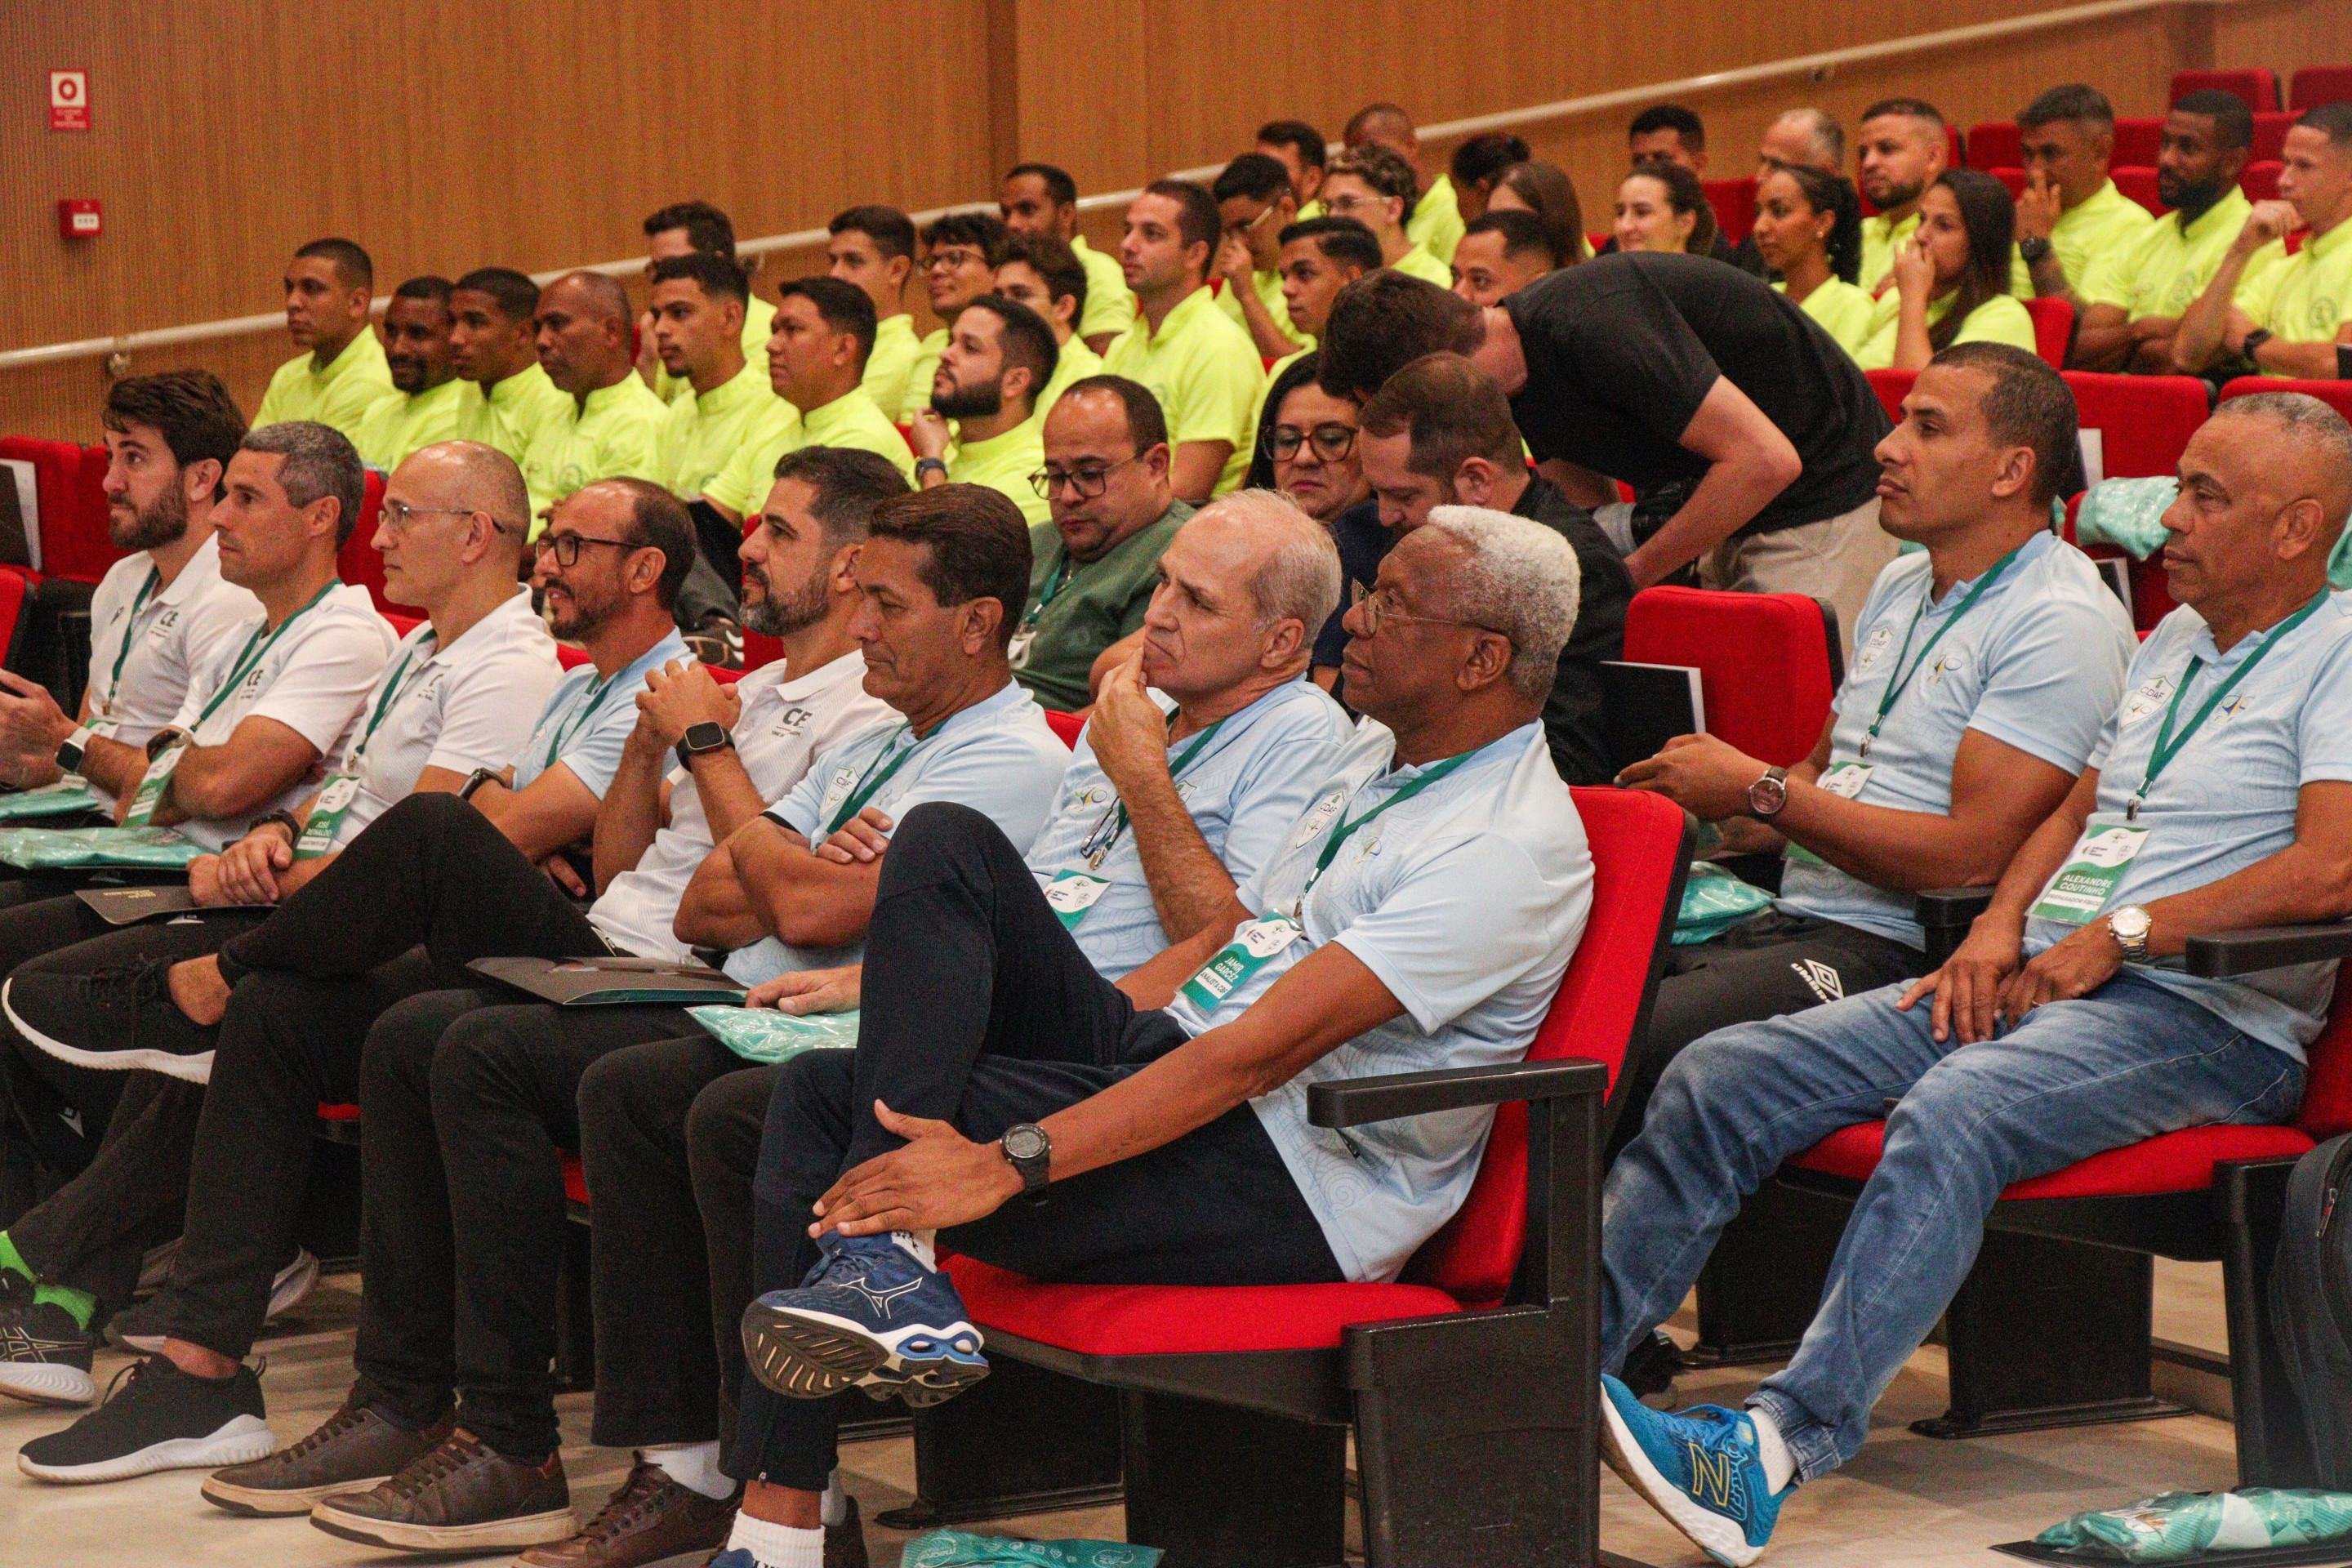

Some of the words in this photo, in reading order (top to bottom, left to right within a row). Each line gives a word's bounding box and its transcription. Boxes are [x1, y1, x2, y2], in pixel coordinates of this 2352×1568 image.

[2140, 686, 2165, 700] CDAF
[2059, 882, 2106, 896] COUTINHO
[2063, 874, 2114, 889] ALEXANDRE
[1224, 956, 1245, 975] JAMIR
[1200, 971, 1219, 988] ANALISTA
